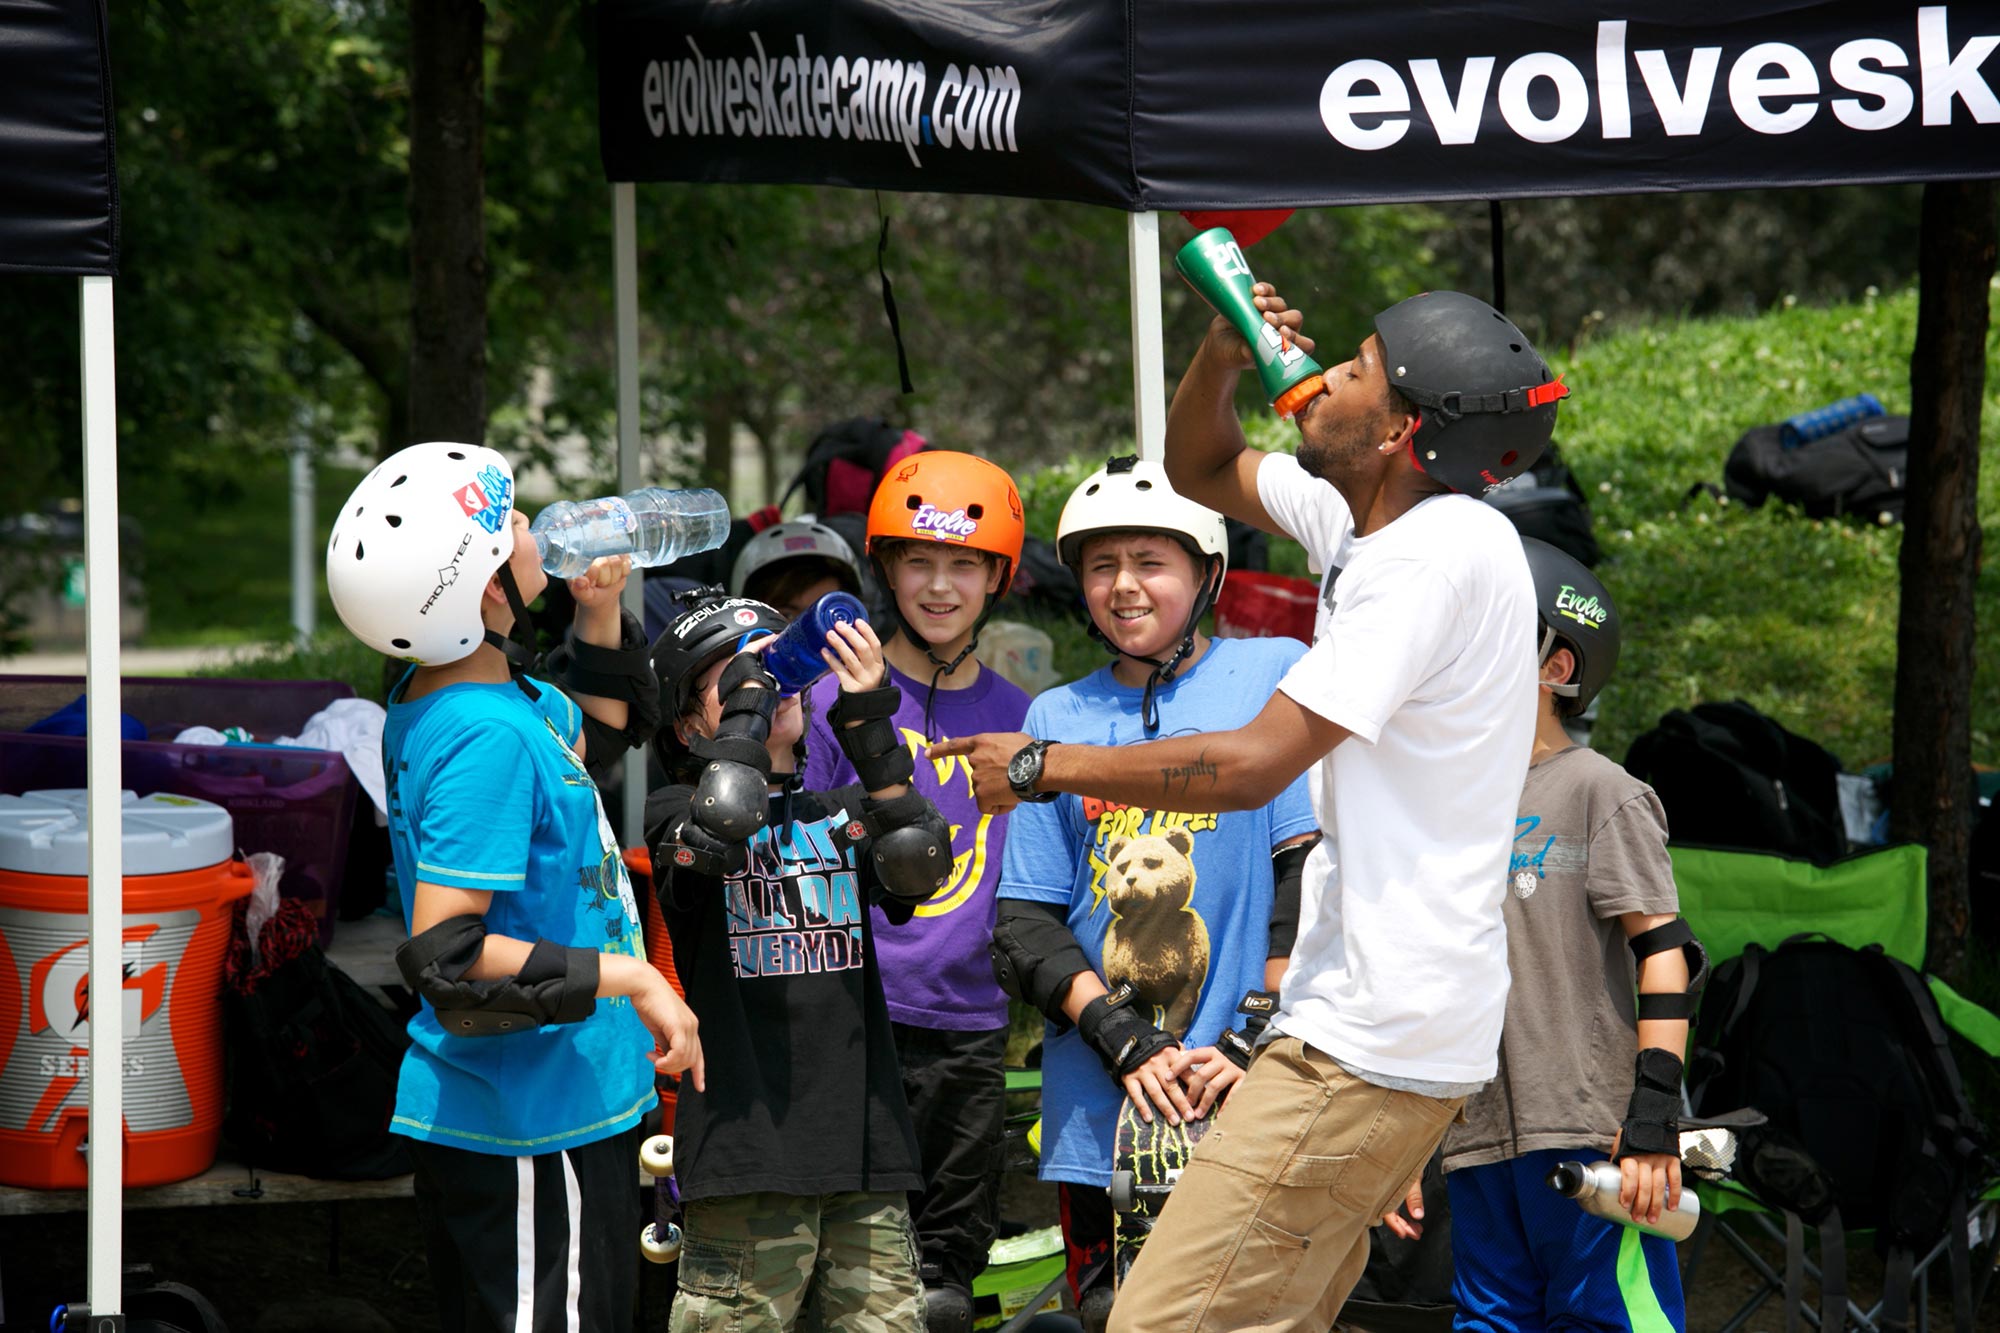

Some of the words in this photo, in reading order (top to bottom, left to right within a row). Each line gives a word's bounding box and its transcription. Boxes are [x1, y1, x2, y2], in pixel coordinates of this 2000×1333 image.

[643, 31, 1022, 168] evolveskatecamp.com
[1319, 6, 2000, 151] evolvesk
[911, 504, 977, 536] Evolve
[419, 584, 444, 615] PRO
[450, 532, 472, 565] TEC
[692, 598, 780, 623] BILLABO
[1556, 585, 1607, 623] Evolve
[723, 808, 857, 881] KAT
[1096, 806, 1143, 846] FOR
[724, 879, 797, 934] ALL
[796, 871, 863, 928] DA
[40, 1055, 145, 1077] SES
